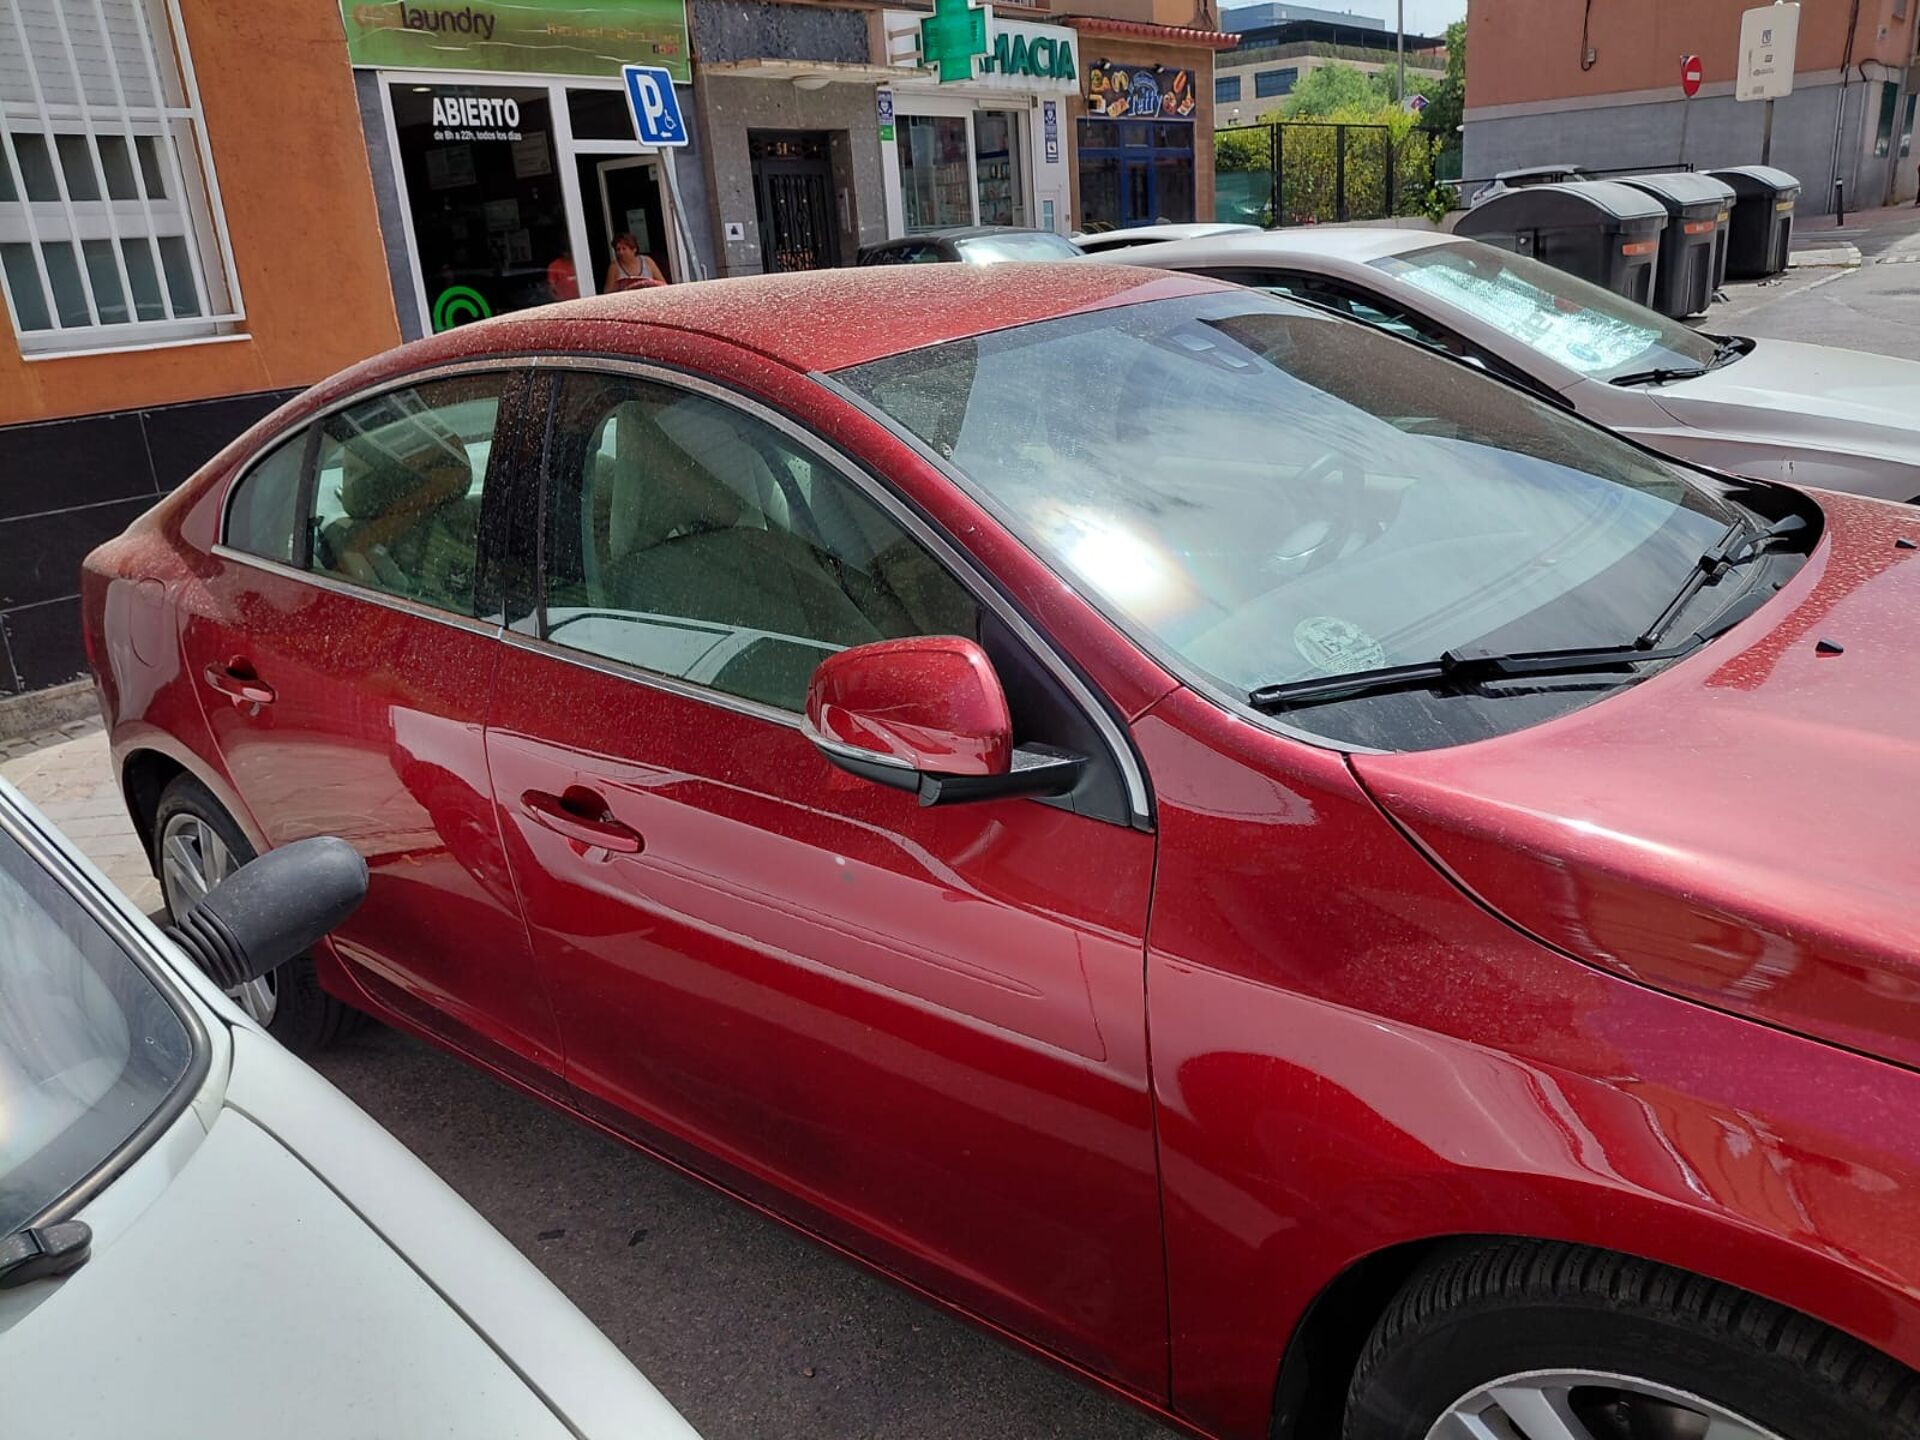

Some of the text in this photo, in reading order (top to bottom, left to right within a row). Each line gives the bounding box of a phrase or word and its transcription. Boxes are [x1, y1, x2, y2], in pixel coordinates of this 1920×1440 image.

[401, 2, 495, 39] laundry
[915, 33, 1076, 80] MACIA
[432, 97, 520, 127] ABIERTO
[636, 74, 663, 135] P
